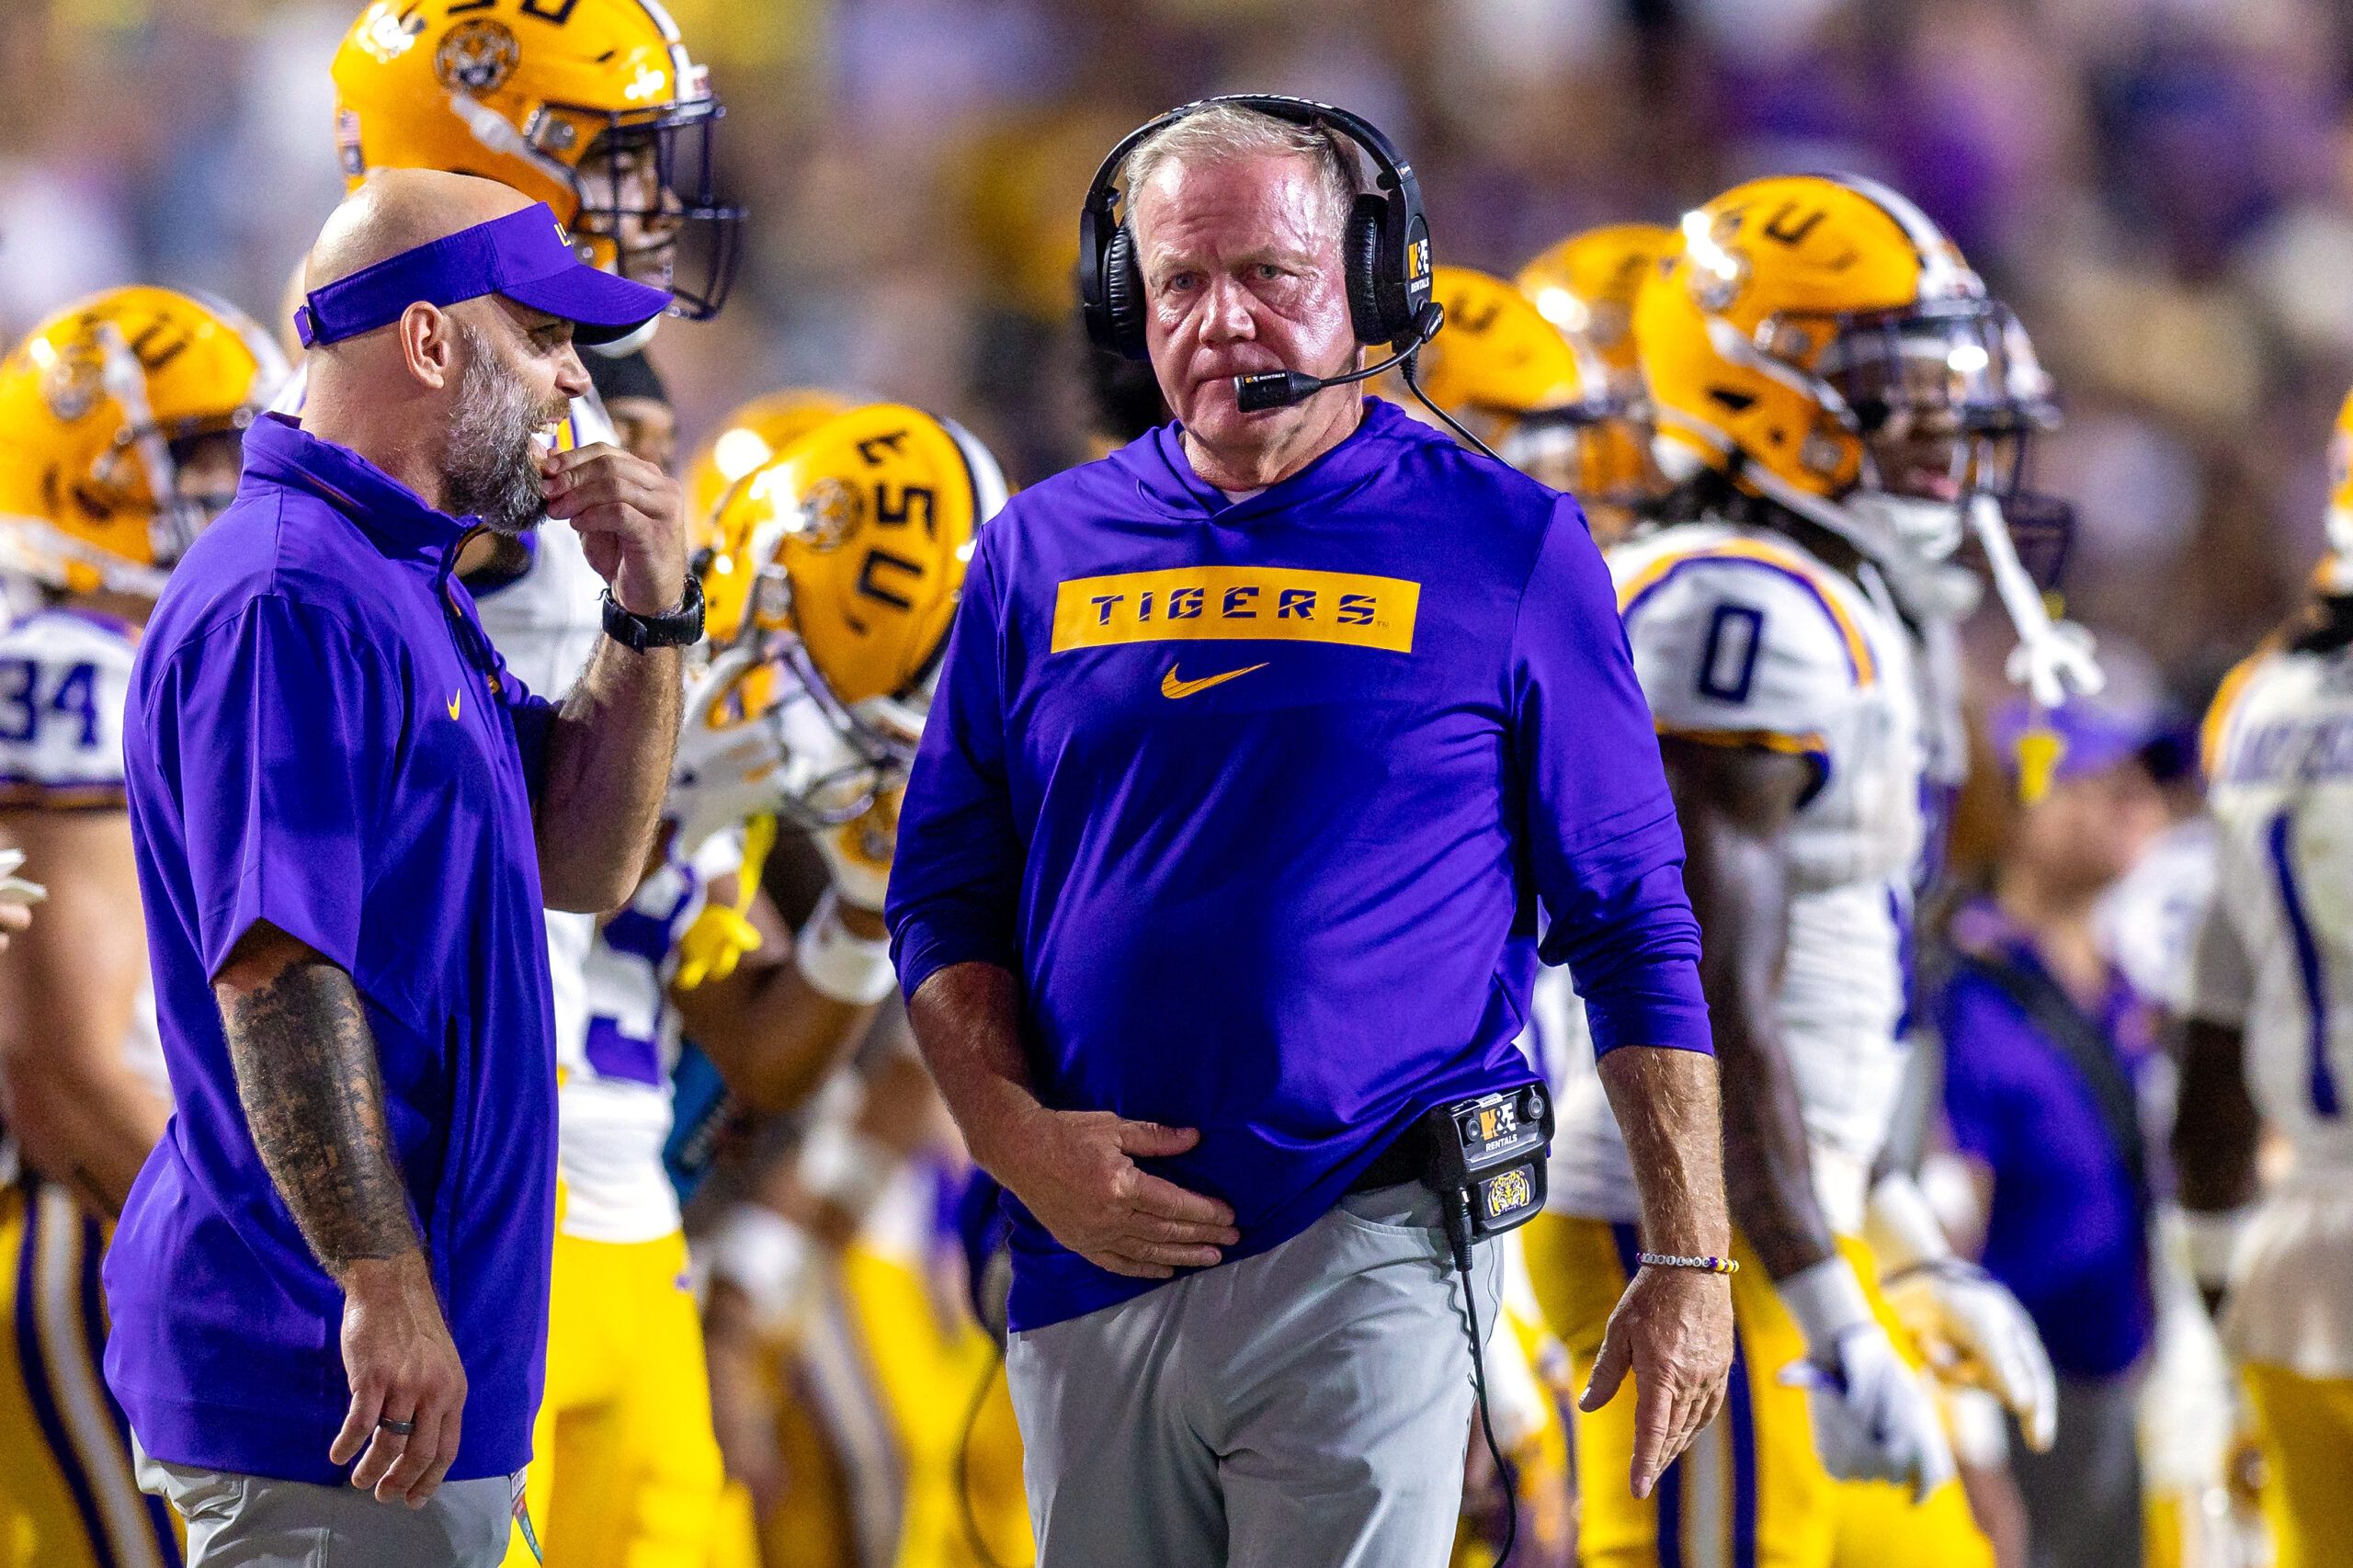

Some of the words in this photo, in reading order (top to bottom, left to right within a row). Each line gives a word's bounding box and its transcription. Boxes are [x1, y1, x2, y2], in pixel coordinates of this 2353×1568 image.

[1411, 278, 1429, 293] RENTALS
[1091, 585, 1377, 627] TIGERS
[1699, 603, 1763, 702] 0
[0, 659, 97, 746] 34
[1480, 1103, 1517, 1141] K&E
[1485, 1134, 1518, 1152] RENTALS
